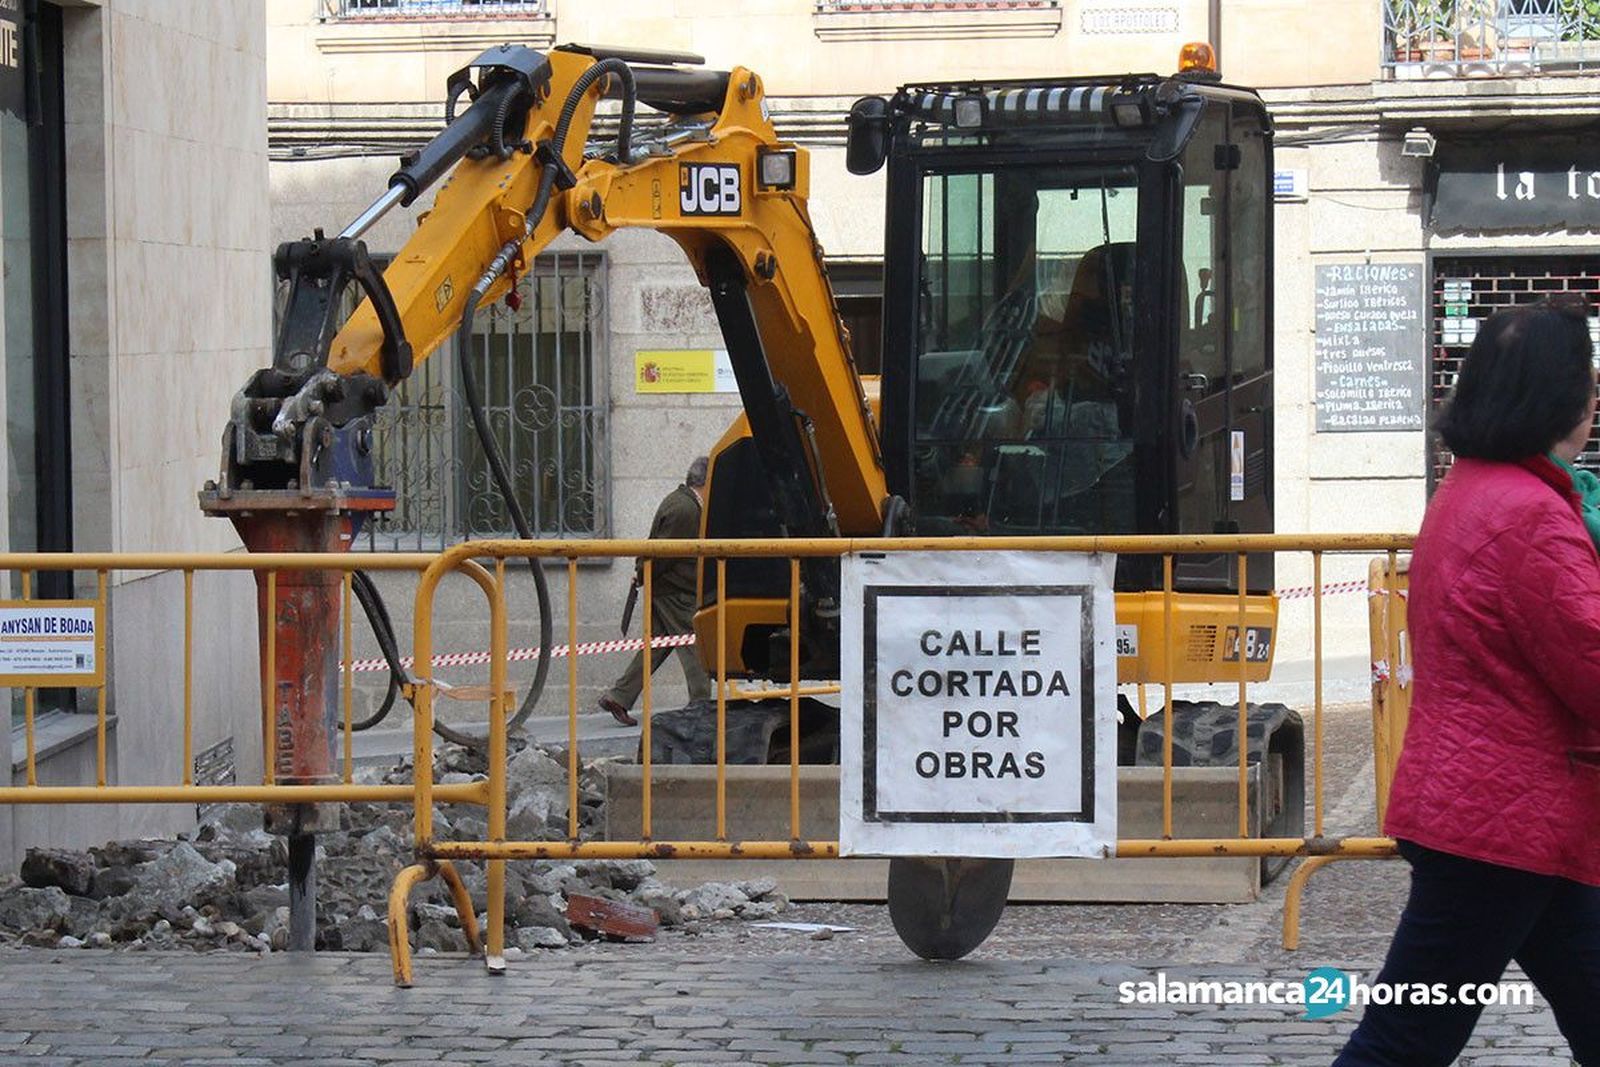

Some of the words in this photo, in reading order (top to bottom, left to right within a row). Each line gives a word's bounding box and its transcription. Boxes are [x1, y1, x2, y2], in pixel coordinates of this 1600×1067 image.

[680, 166, 740, 212] JCB
[1496, 162, 1535, 200] la
[44, 617, 57, 633] DE
[60, 617, 94, 633] BOADA
[920, 629, 1041, 657] CALLE
[890, 670, 1071, 697] CORTADA
[942, 711, 1020, 738] POR
[915, 751, 1046, 779] OBRAS
